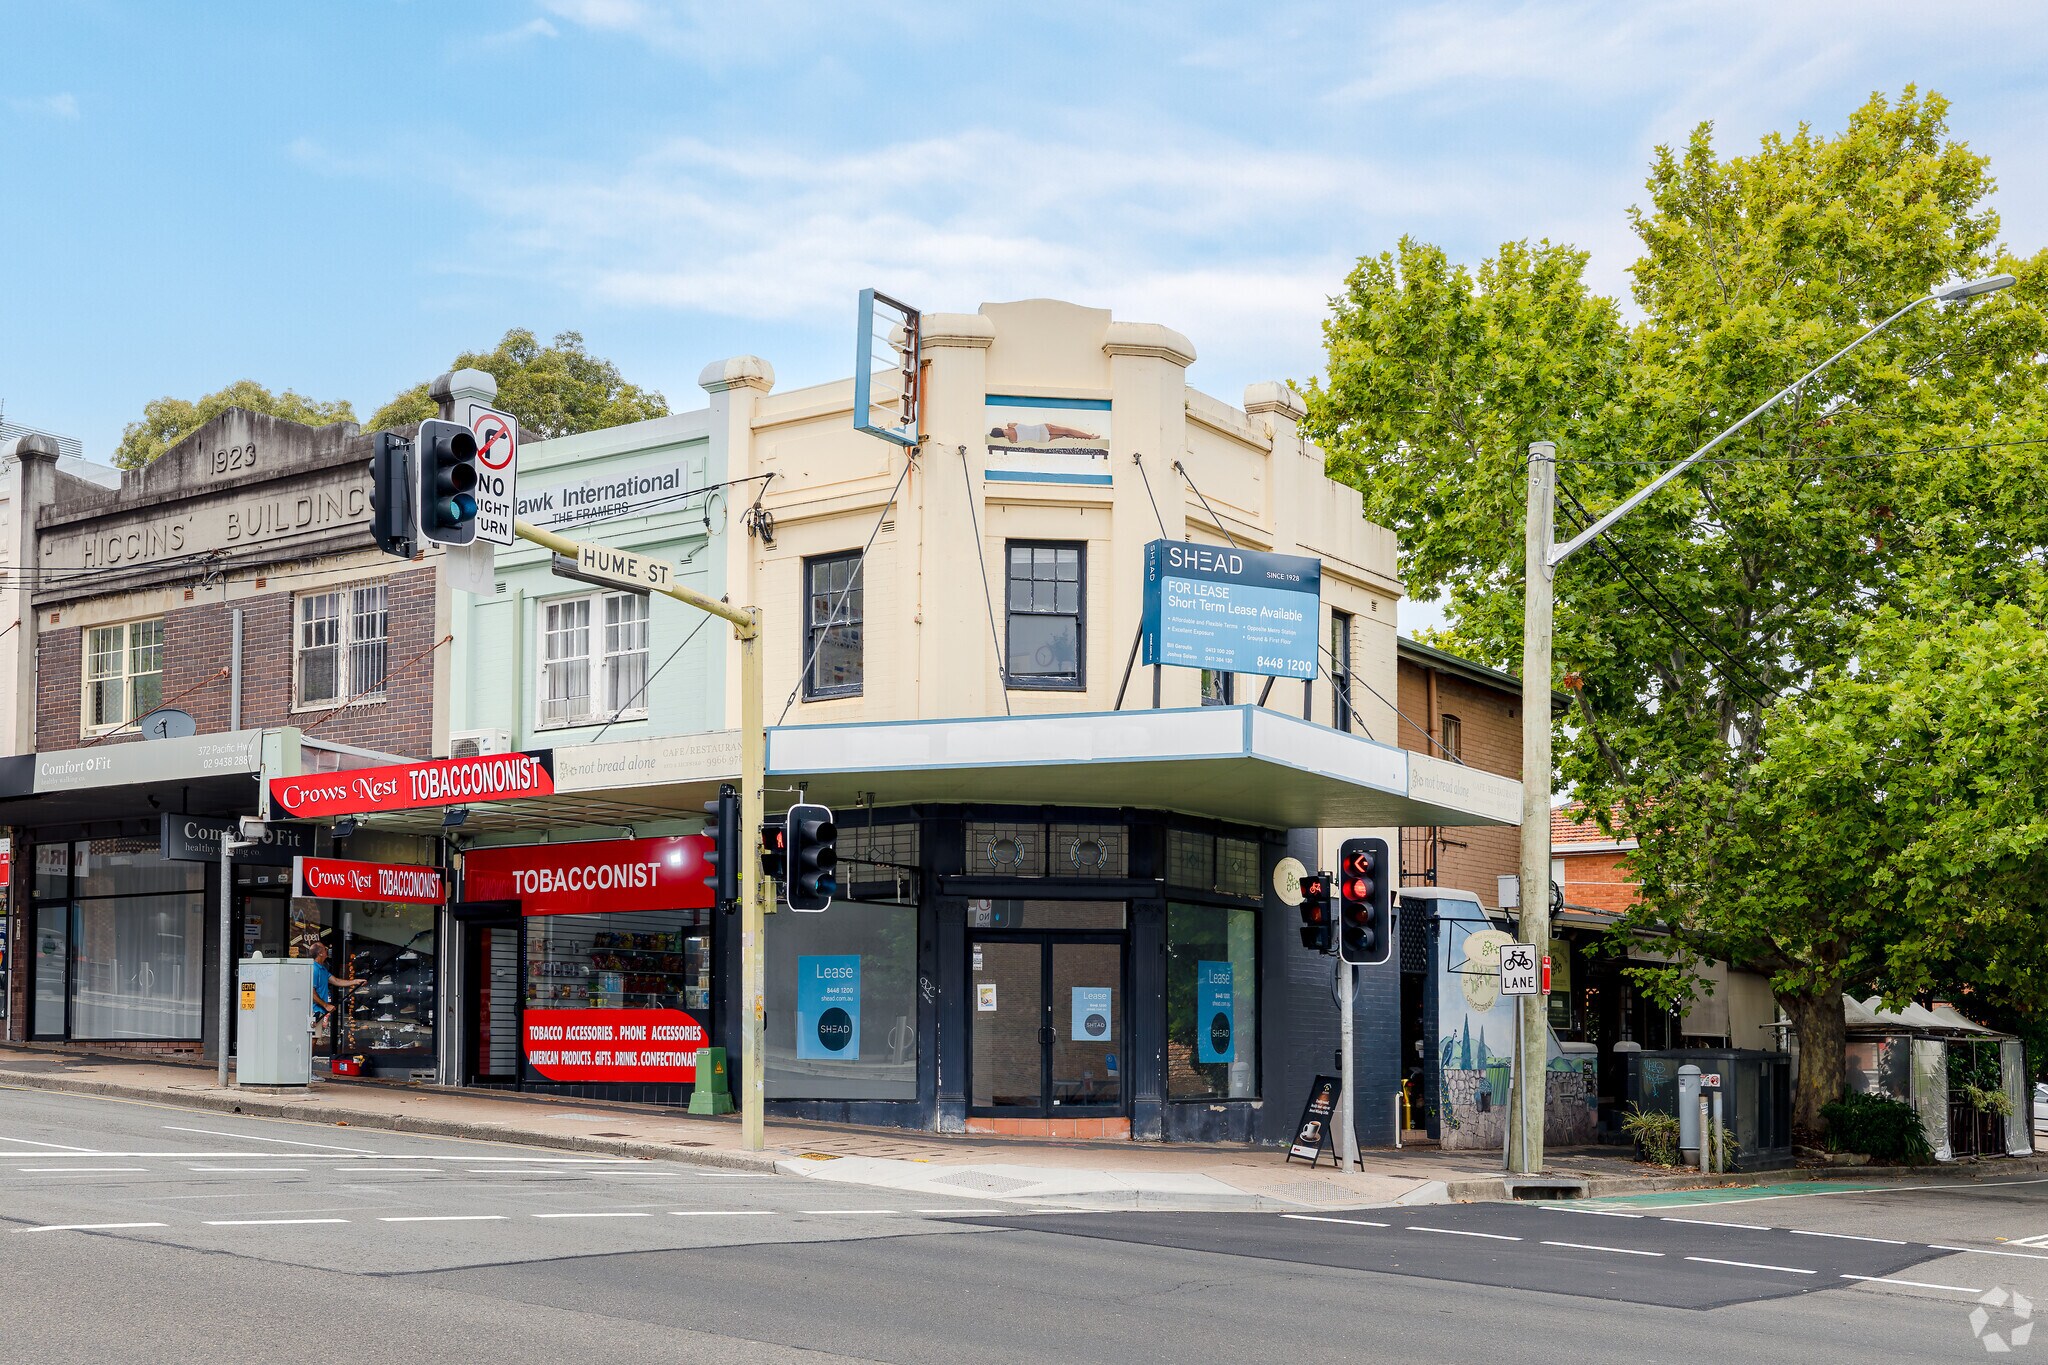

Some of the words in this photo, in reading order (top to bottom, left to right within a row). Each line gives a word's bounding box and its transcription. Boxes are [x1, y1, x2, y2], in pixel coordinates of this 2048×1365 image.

[210, 442, 256, 475] 1923
[478, 472, 504, 497] NO
[515, 492, 553, 516] awk
[563, 468, 680, 508] International
[227, 485, 376, 540] BUILDING
[553, 511, 573, 525] THE
[576, 501, 629, 521] FRAMERS
[584, 548, 638, 578] HUME
[648, 564, 669, 584] ST
[1169, 547, 1243, 575] SHEAD
[1266, 571, 1285, 580] SINCE
[1286, 574, 1300, 582] 1928
[1168, 581, 1191, 595] FOR
[1194, 584, 1230, 599] LEASE
[1168, 595, 1196, 609] Short
[1199, 599, 1225, 613] Term
[1228, 602, 1257, 616] Lease
[1260, 606, 1303, 622] Available
[1193, 629, 1214, 637] Exposure
[1257, 656, 1283, 669] 8448
[1287, 660, 1312, 672] 1200
[198, 745, 211, 756] 372
[212, 743, 235, 755] Pacific
[236, 743, 254, 755] Hwy
[663, 742, 743, 758] CAFE/RESTAURAN
[41, 760, 84, 776] Comfort
[95, 757, 112, 771] Fit
[203, 758, 213, 769] 02
[214, 757, 232, 768] 9438
[234, 755, 253, 766] 2887
[578, 760, 594, 775] not
[597, 755, 627, 773] bread
[628, 754, 656, 771] alone
[706, 755, 727, 768] 9966
[409, 756, 541, 801] TOBACCONONIST
[283, 784, 347, 809] Crows
[352, 777, 398, 803] Nest
[184, 822, 242, 842] Comfo
[276, 829, 301, 847] Fit
[185, 842, 215, 855] healthy
[308, 866, 345, 888] Crows
[348, 869, 372, 893] Nest
[378, 868, 441, 899] TOBACCONONIST
[512, 862, 661, 894] TOBACCONIST
[816, 964, 853, 979] Lease
[1209, 969, 1231, 985] Lease
[1504, 976, 1534, 989] LANE
[1083, 991, 1107, 1000] Lease
[529, 1026, 563, 1041] TOBACCO
[620, 1025, 647, 1040] PHONE
[651, 1025, 702, 1041] ACCESSORIES
[820, 1025, 850, 1034] SHEAD
[1212, 1029, 1230, 1038] SHEAD
[529, 1050, 559, 1065] AMERICAN
[640, 1051, 697, 1067] CONFECTIONAR
